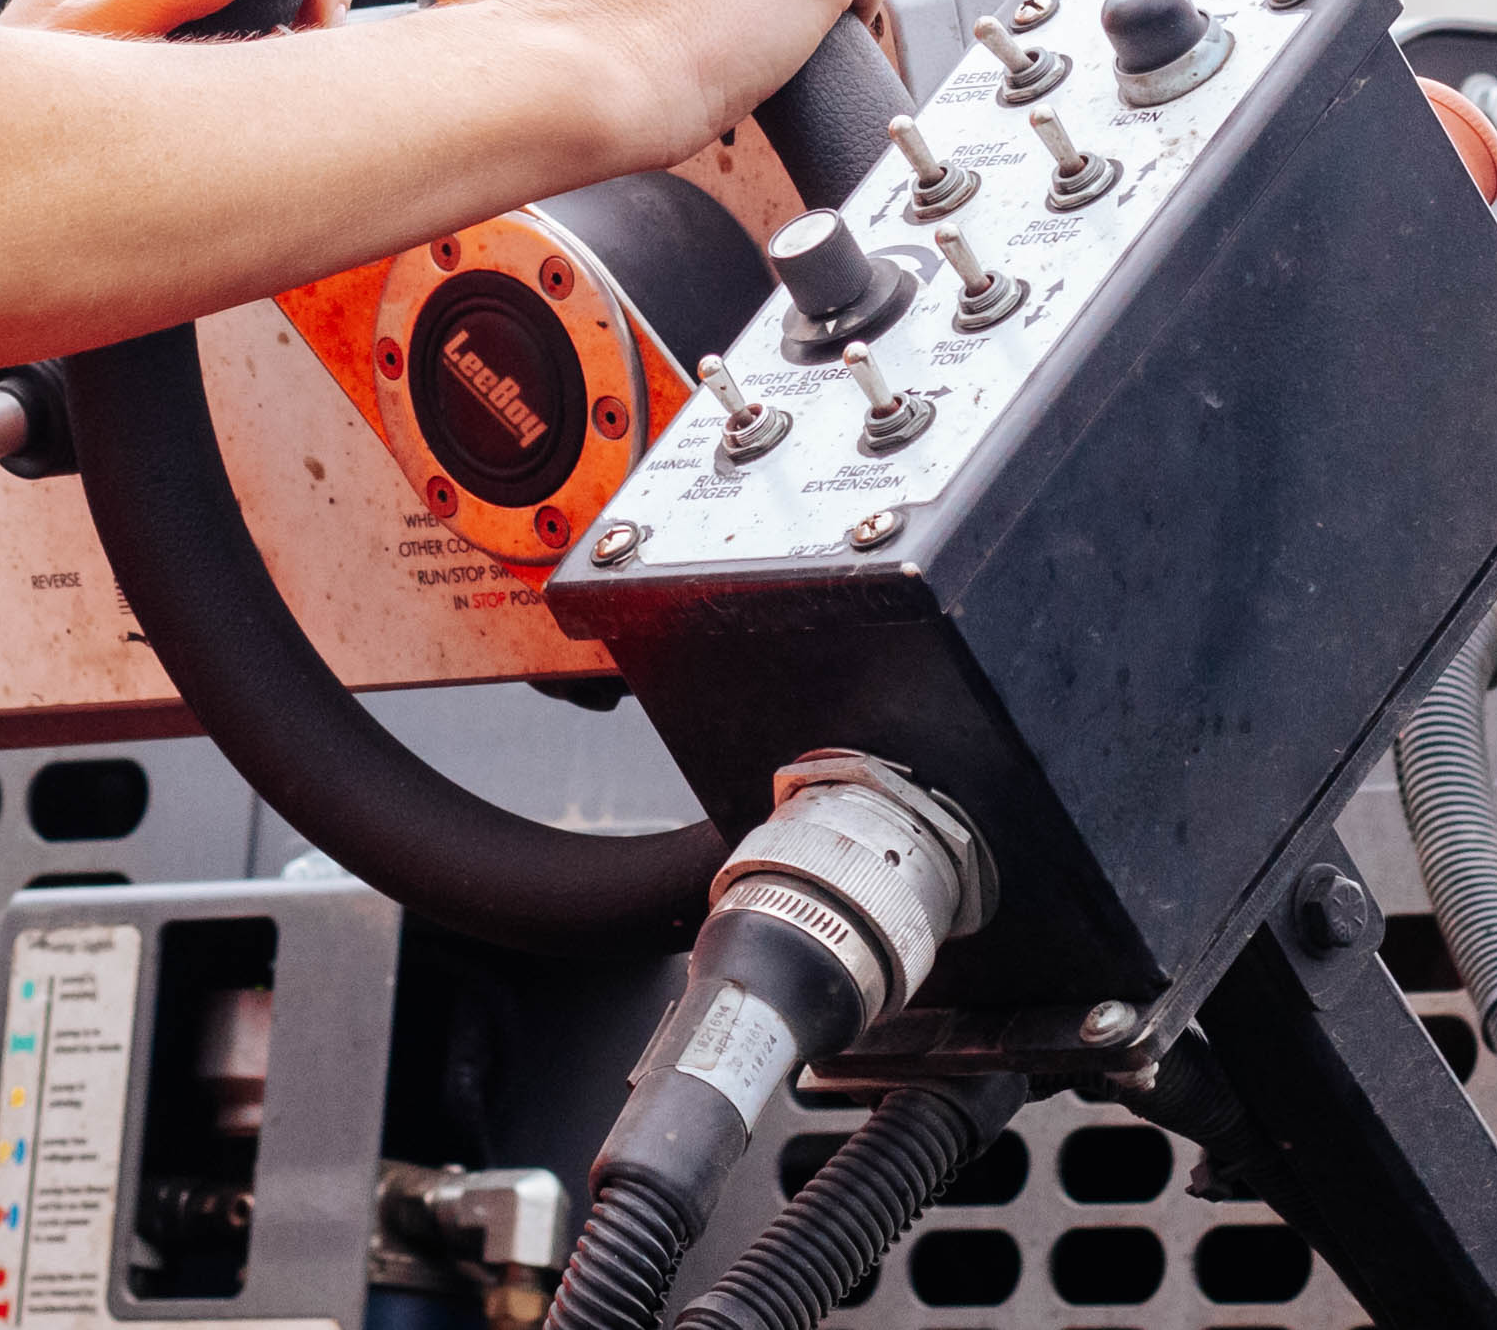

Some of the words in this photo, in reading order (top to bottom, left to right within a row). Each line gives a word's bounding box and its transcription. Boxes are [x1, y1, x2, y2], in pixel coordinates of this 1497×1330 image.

[935, 89, 993, 105] SLOPE
[1109, 110, 1164, 127] HORN
[951, 142, 1009, 157] RIGHT
[1024, 216, 1085, 233] RIGHT
[1006, 229, 1082, 247] CUTOFF
[930, 338, 991, 354] RIGHT
[929, 352, 972, 366] TOW
[741, 371, 799, 387] RIGHT
[442, 329, 550, 449] LeeBoy
[760, 382, 822, 398] SPEED
[678, 437, 711, 449] OFF
[692, 471, 751, 487] RIGHT
[834, 463, 895, 479] RIGHT
[800, 476, 907, 493] EXTENSION
[676, 485, 744, 502] AUGER
[398, 540, 444, 557] OTHER
[30, 572, 82, 590] REVERSE
[417, 566, 485, 585] RUN/STOP
[453, 595, 469, 610] IN
[472, 592, 506, 609] STOP
